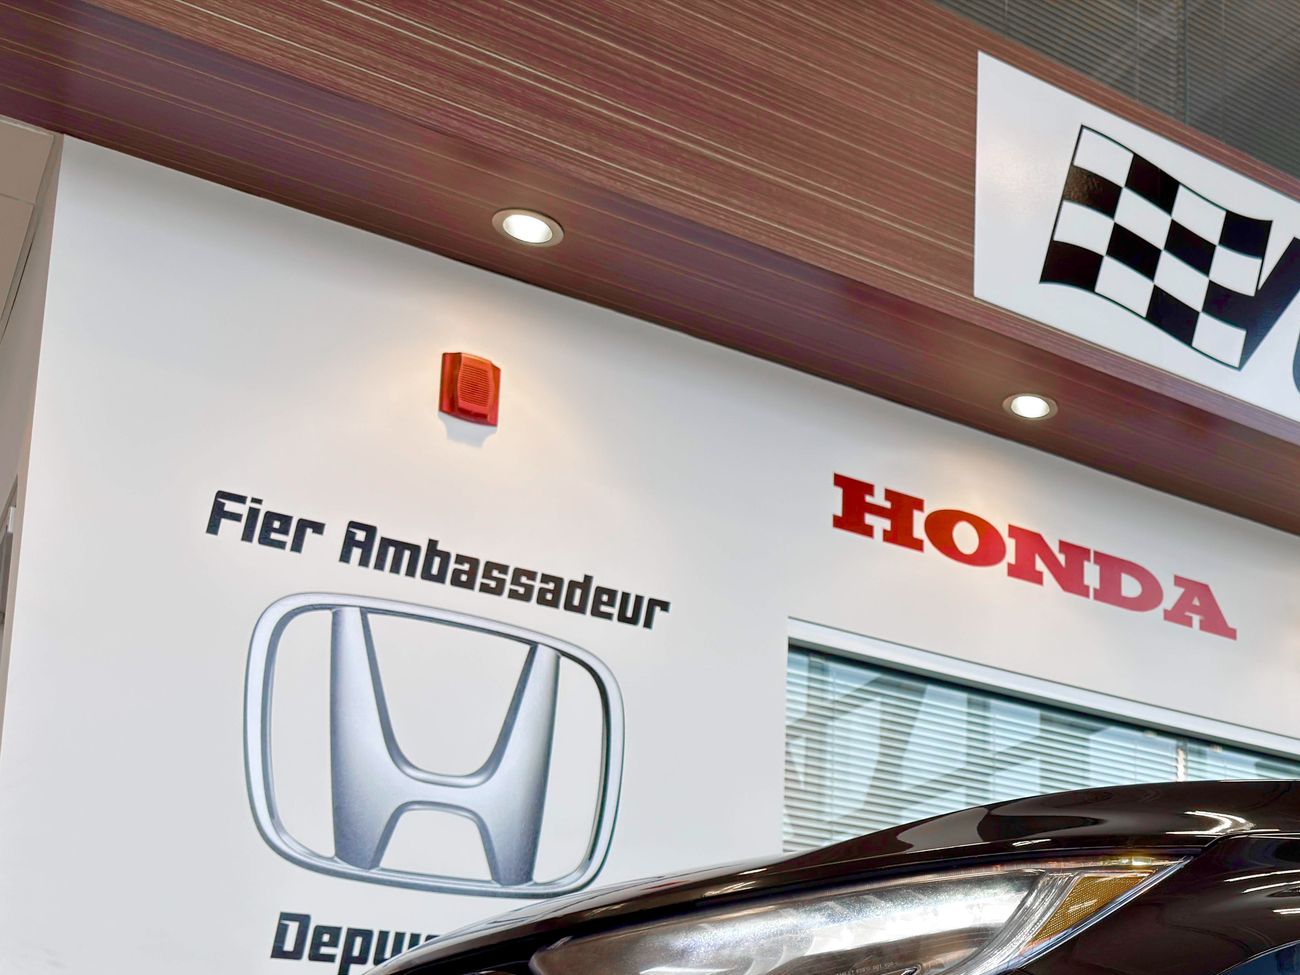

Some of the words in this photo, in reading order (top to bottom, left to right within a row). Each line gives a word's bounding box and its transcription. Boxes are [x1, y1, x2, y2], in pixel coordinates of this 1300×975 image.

[206, 490, 325, 554] Fier
[339, 520, 671, 630] Ambassadeur
[832, 473, 1237, 641] HONDA
